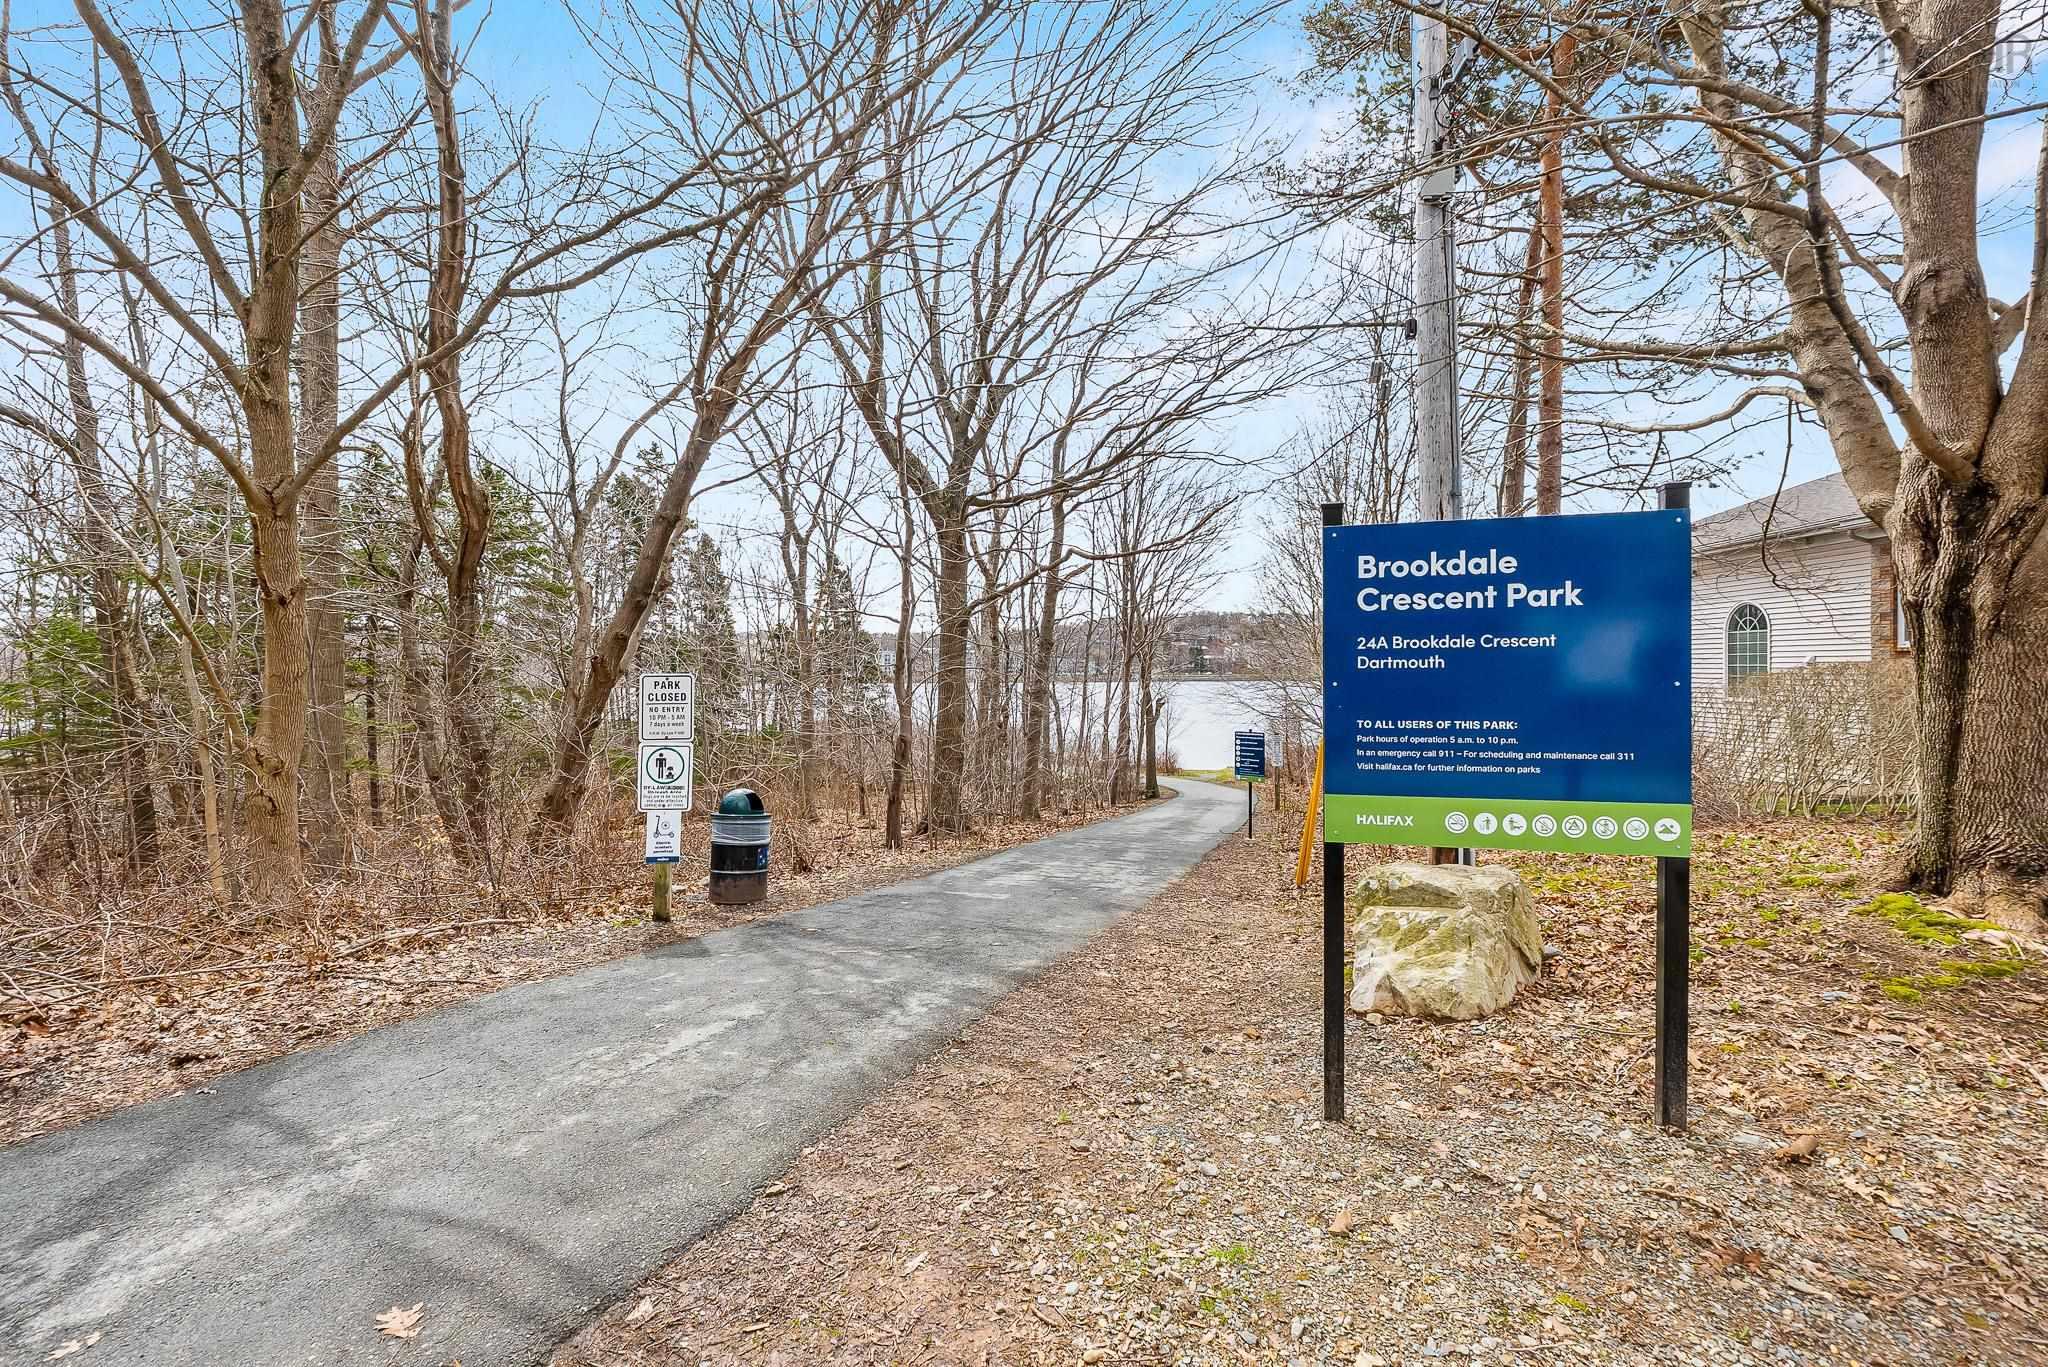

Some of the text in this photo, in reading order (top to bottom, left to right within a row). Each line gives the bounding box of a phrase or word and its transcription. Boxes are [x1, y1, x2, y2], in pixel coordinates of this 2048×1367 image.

[1358, 549, 1517, 578] Brookdale
[1357, 581, 1583, 611] Crescent Park
[1357, 634, 1556, 649] 24A Brookdale Crescent
[1358, 655, 1444, 668] Dartmouth
[654, 680, 680, 690] PARK
[648, 692, 687, 702] CLOSED
[1357, 720, 1517, 730] TO ALL USERS OF THIS PARK:
[1357, 735, 1374, 743] Park
[1410, 736, 1448, 745] operation
[1450, 736, 1455, 744] 5
[1488, 737, 1498, 745] 10
[1501, 738, 1518, 746] p.m.
[1377, 751, 1421, 759] emergency
[1439, 750, 1454, 758] 911
[1479, 751, 1523, 761] scheduling
[1525, 752, 1541, 760] and
[1544, 752, 1598, 760] maintenance
[1600, 753, 1615, 761] call
[1617, 753, 1633, 761] 311
[1376, 763, 1412, 771] halifax.ca
[1414, 764, 1425, 772] for
[1427, 764, 1454, 772] further
[1457, 764, 1502, 773] information
[1517, 766, 1540, 775] parks
[1357, 815, 1413, 825] HALIFAX
